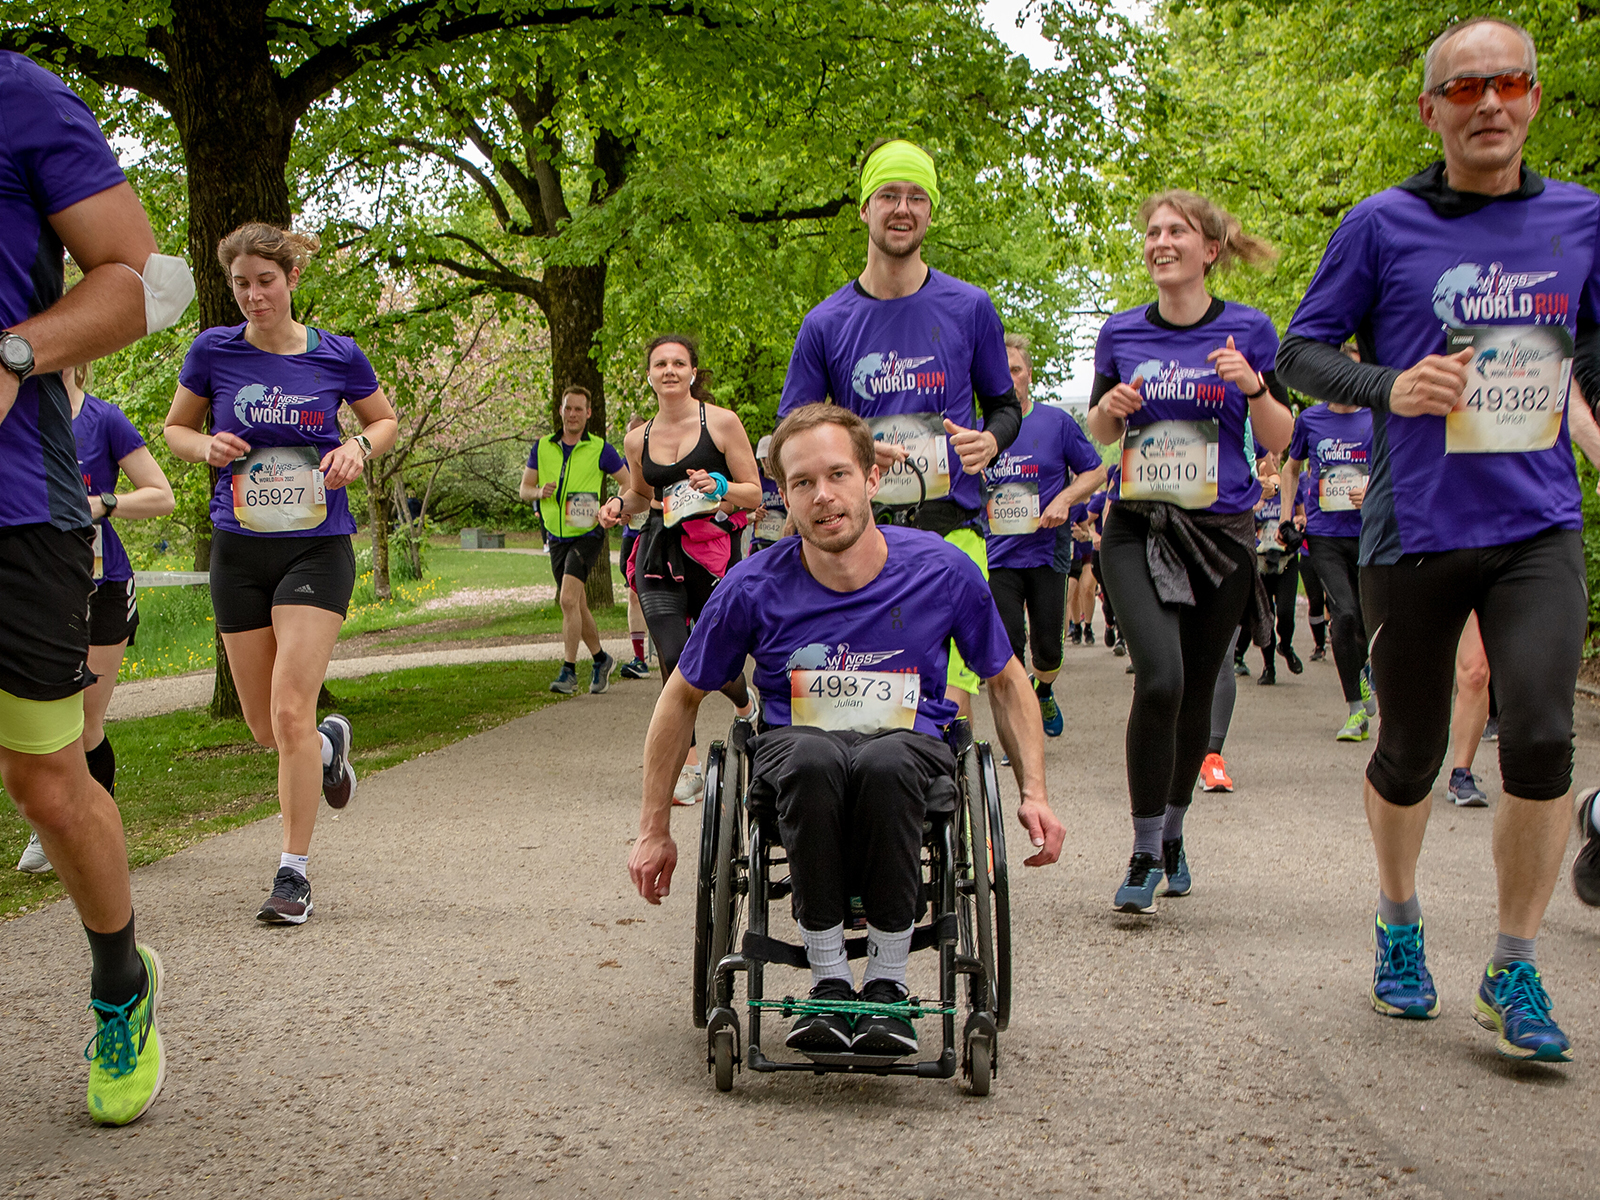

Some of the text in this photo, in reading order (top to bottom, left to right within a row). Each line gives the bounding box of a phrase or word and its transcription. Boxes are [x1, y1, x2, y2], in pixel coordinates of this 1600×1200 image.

[1460, 292, 1569, 321] WORLD RUN
[869, 372, 945, 395] WORLD RUN
[1144, 381, 1225, 401] WORLD RUN
[1466, 384, 1566, 413] 49382 2
[249, 406, 325, 426] WORLD RUN
[938, 457, 947, 470] 4
[1325, 451, 1366, 460] WORLD RUN
[993, 464, 1038, 477] WORLD RUN
[1135, 462, 1216, 482] 19010 4
[1149, 481, 1180, 491] Viktoria
[246, 486, 325, 507] 65927 3
[570, 508, 595, 517] 65412
[994, 507, 1028, 519] 50969
[826, 652, 875, 666] WINGS
[808, 674, 892, 702] 49373
[904, 689, 917, 704] 4
[834, 698, 864, 709] Julian
